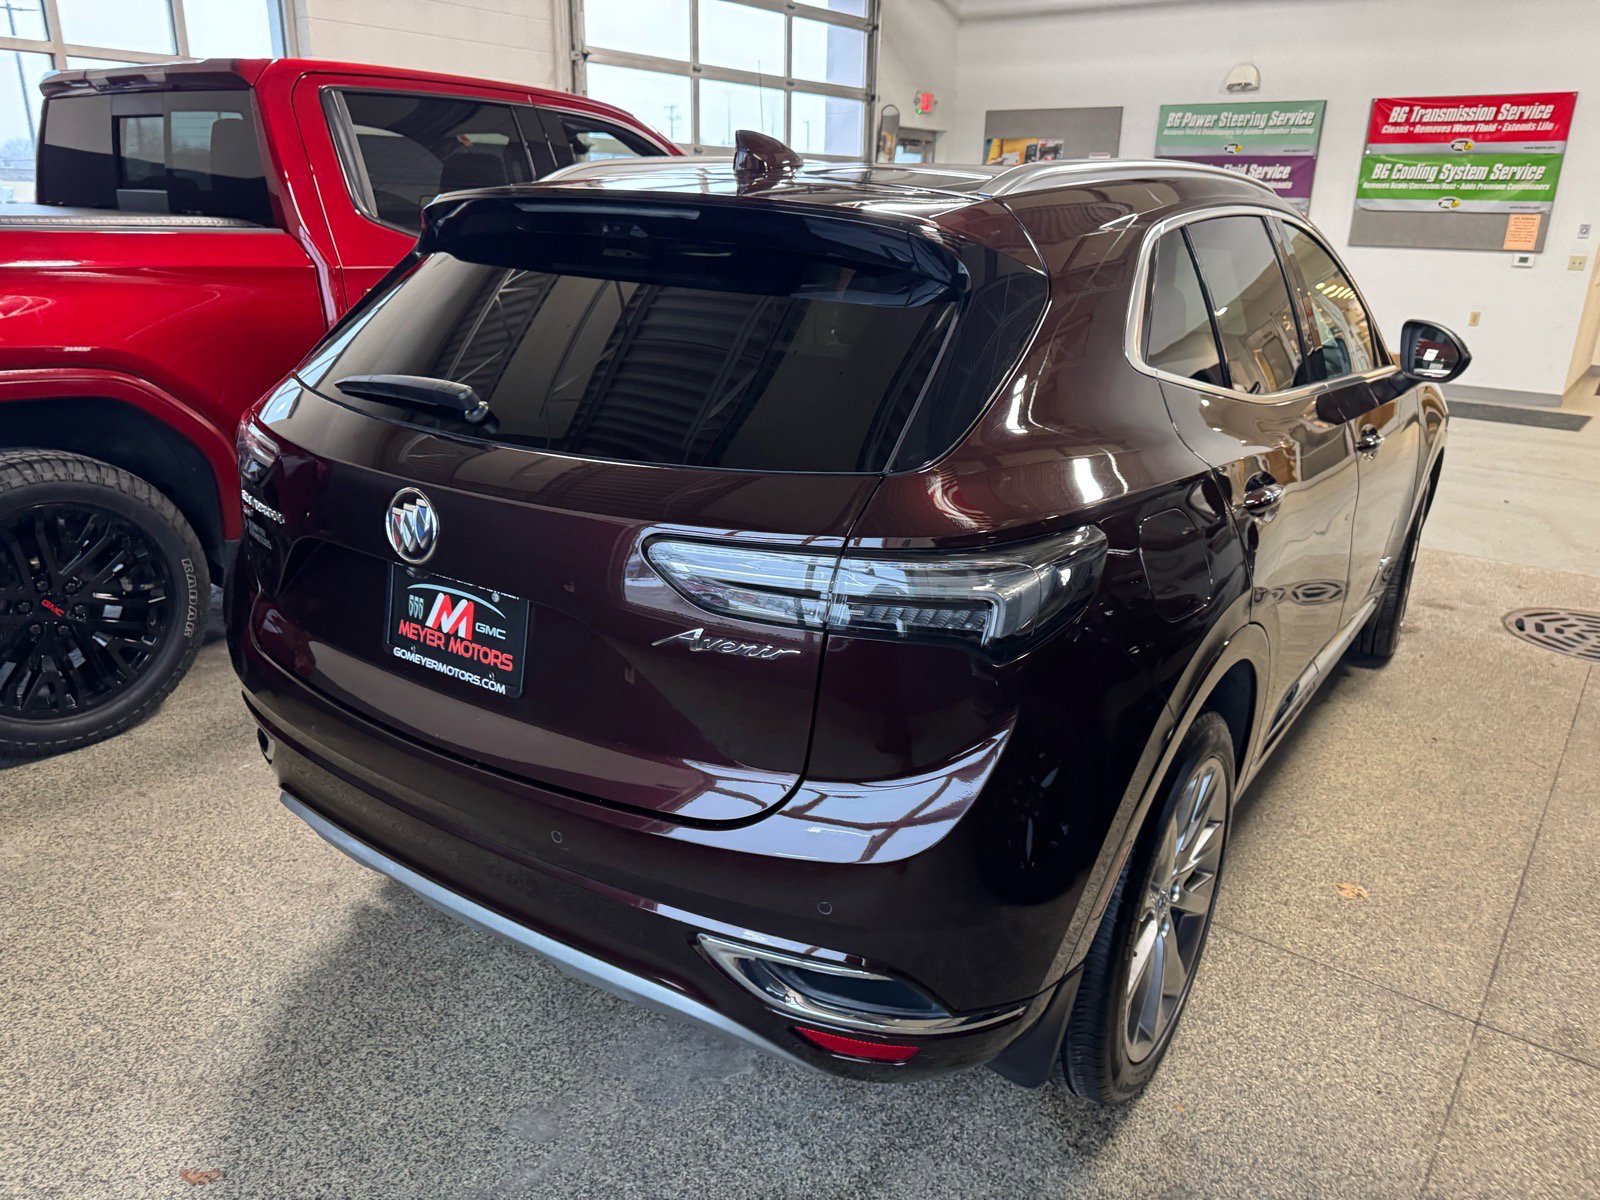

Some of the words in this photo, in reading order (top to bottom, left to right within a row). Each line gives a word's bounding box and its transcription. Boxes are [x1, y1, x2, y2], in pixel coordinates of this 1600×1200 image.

[1167, 113, 1182, 126] BG
[1182, 113, 1217, 126] Power
[1219, 112, 1268, 127] Steering
[1270, 110, 1314, 125] Service
[1389, 107, 1409, 122] BG
[1411, 105, 1497, 122] Transmission
[1498, 103, 1554, 120] Service
[1382, 124, 1408, 133] Cleans
[1415, 124, 1450, 132] Removes
[1452, 123, 1475, 132] Worn
[1476, 122, 1496, 132] Fluid
[1502, 122, 1535, 131] Extends
[1538, 121, 1555, 130] Life
[1248, 165, 1291, 179] Service
[1372, 164, 1391, 179] BG
[1392, 164, 1437, 182] Cooling
[1439, 164, 1488, 182] System
[1490, 164, 1545, 180] Service
[41, 599, 65, 617] GMC
[475, 622, 507, 640] GMC
[398, 619, 445, 650] MEYER
[448, 636, 514, 672] MOTORS
[650, 627, 801, 660] Avenir
[393, 646, 506, 695] GOMEYERMOTORS.COM
